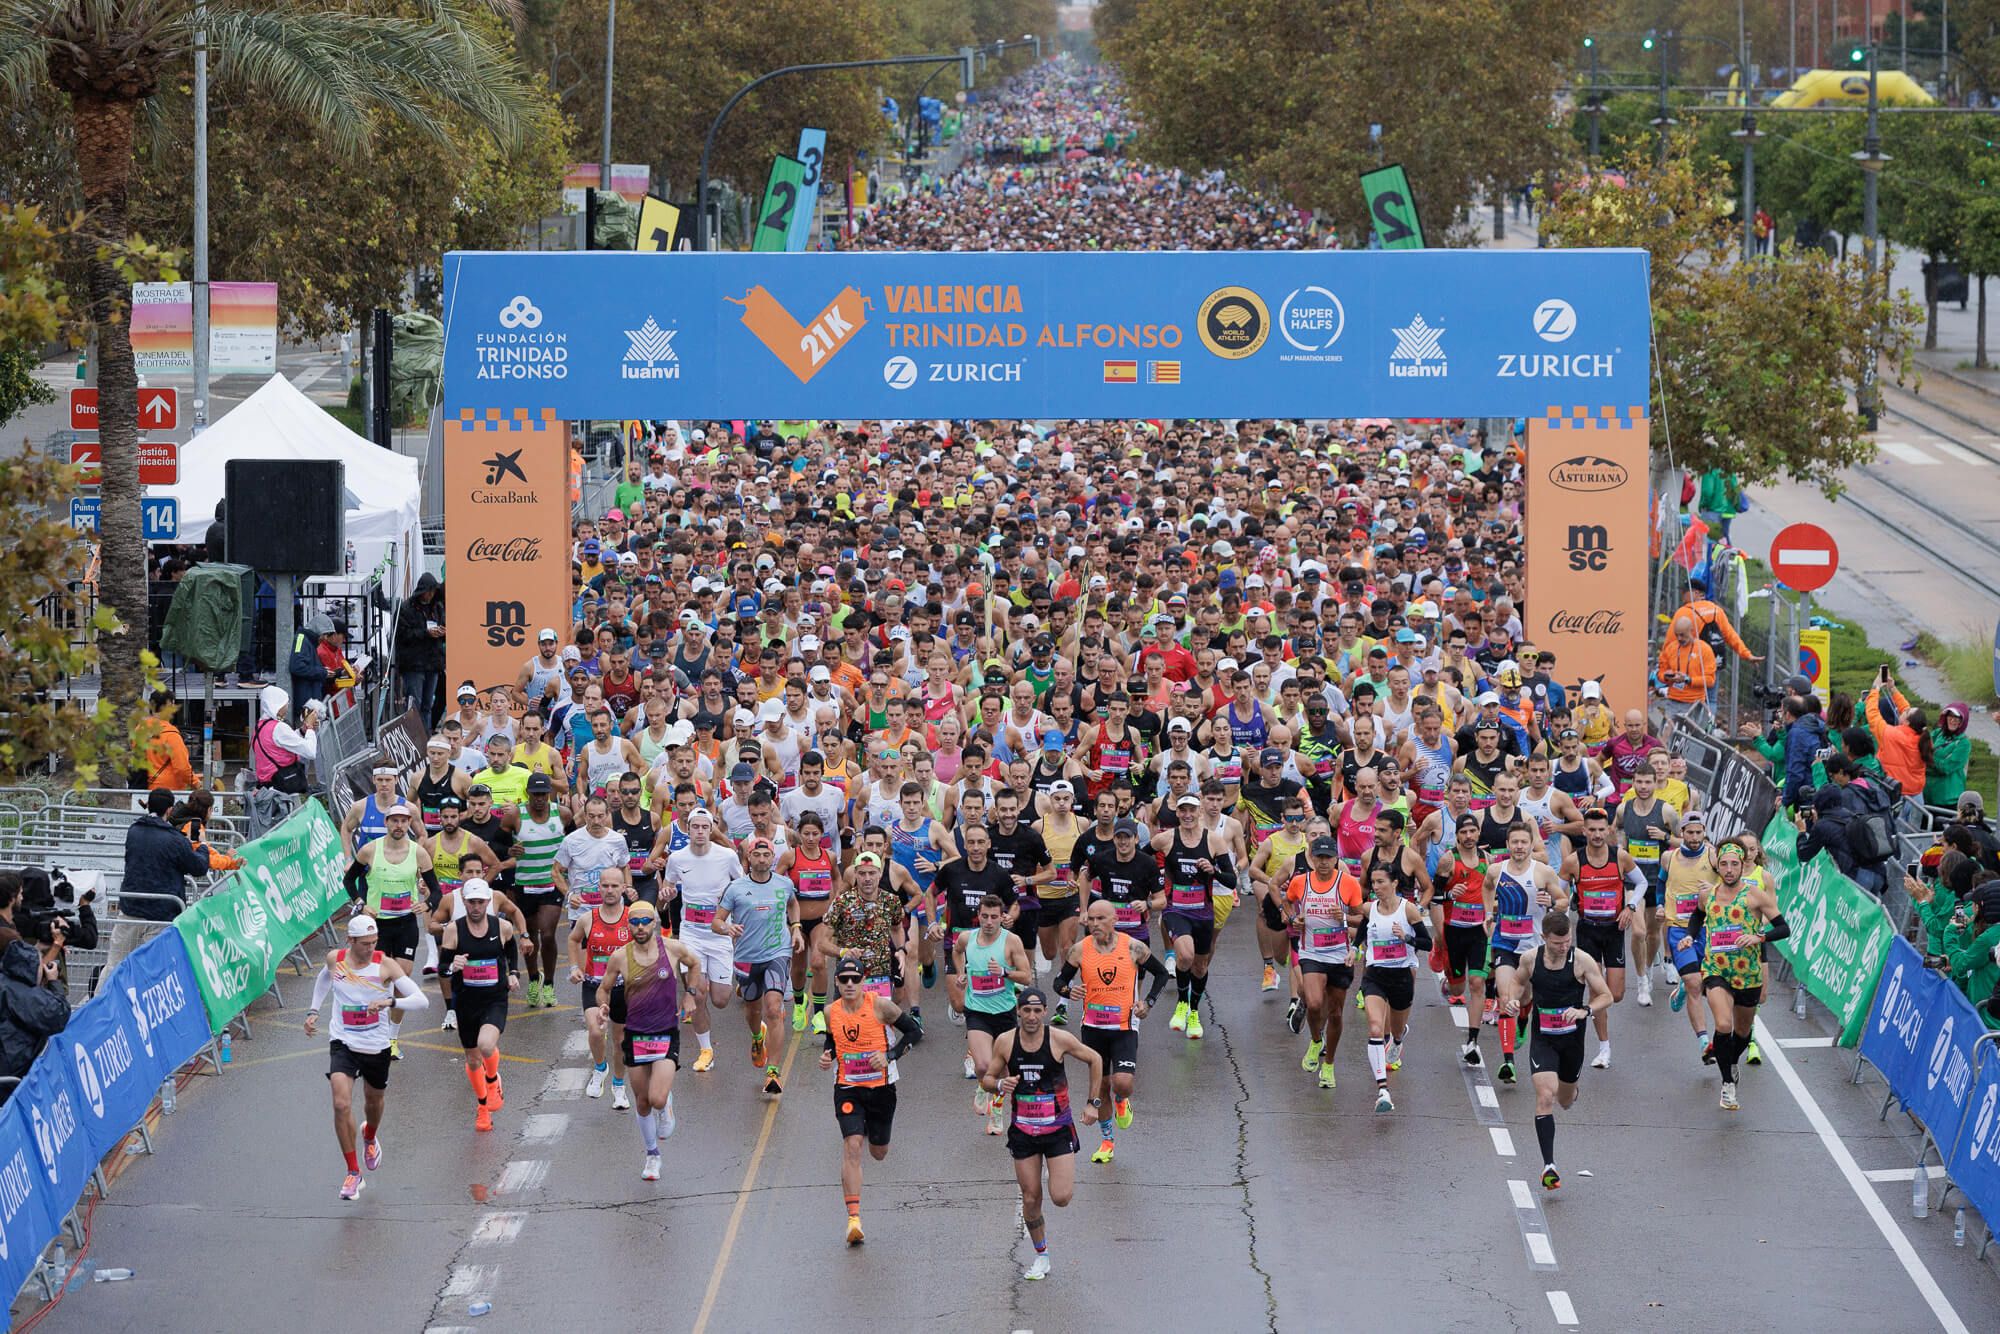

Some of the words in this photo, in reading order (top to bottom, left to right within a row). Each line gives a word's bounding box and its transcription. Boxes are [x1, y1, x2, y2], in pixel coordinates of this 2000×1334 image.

[804, 147, 822, 186] 3
[763, 180, 796, 232] 2
[136, 289, 171, 297] MOSTRA
[173, 289, 185, 297] DE
[884, 285, 1022, 313] VALENCIA
[1291, 308, 1333, 319] SUPER
[1291, 320, 1333, 330] HALFS
[477, 331, 567, 344] FUNDACIÓN
[800, 304, 854, 368] 21K
[884, 324, 1027, 348] TRINIDAD
[1036, 324, 1182, 348] ALFONSO
[137, 351, 170, 359] CINEMA
[171, 351, 187, 359] DEL
[476, 347, 567, 363] TRINIDAD
[476, 364, 568, 380] ALFONSO
[621, 363, 680, 380] luanvi
[929, 364, 1022, 382] ZURICH
[1389, 361, 1447, 377] luanvi
[1497, 354, 1613, 378] ZURICH
[1555, 469, 1622, 484] ASTURIANA
[471, 490, 538, 504] CaixaBank
[74, 503, 95, 512] Punto
[146, 505, 175, 533] 14
[94, 1024, 134, 1089] ZURICH
[1943, 1042, 1971, 1109] ZURICH
